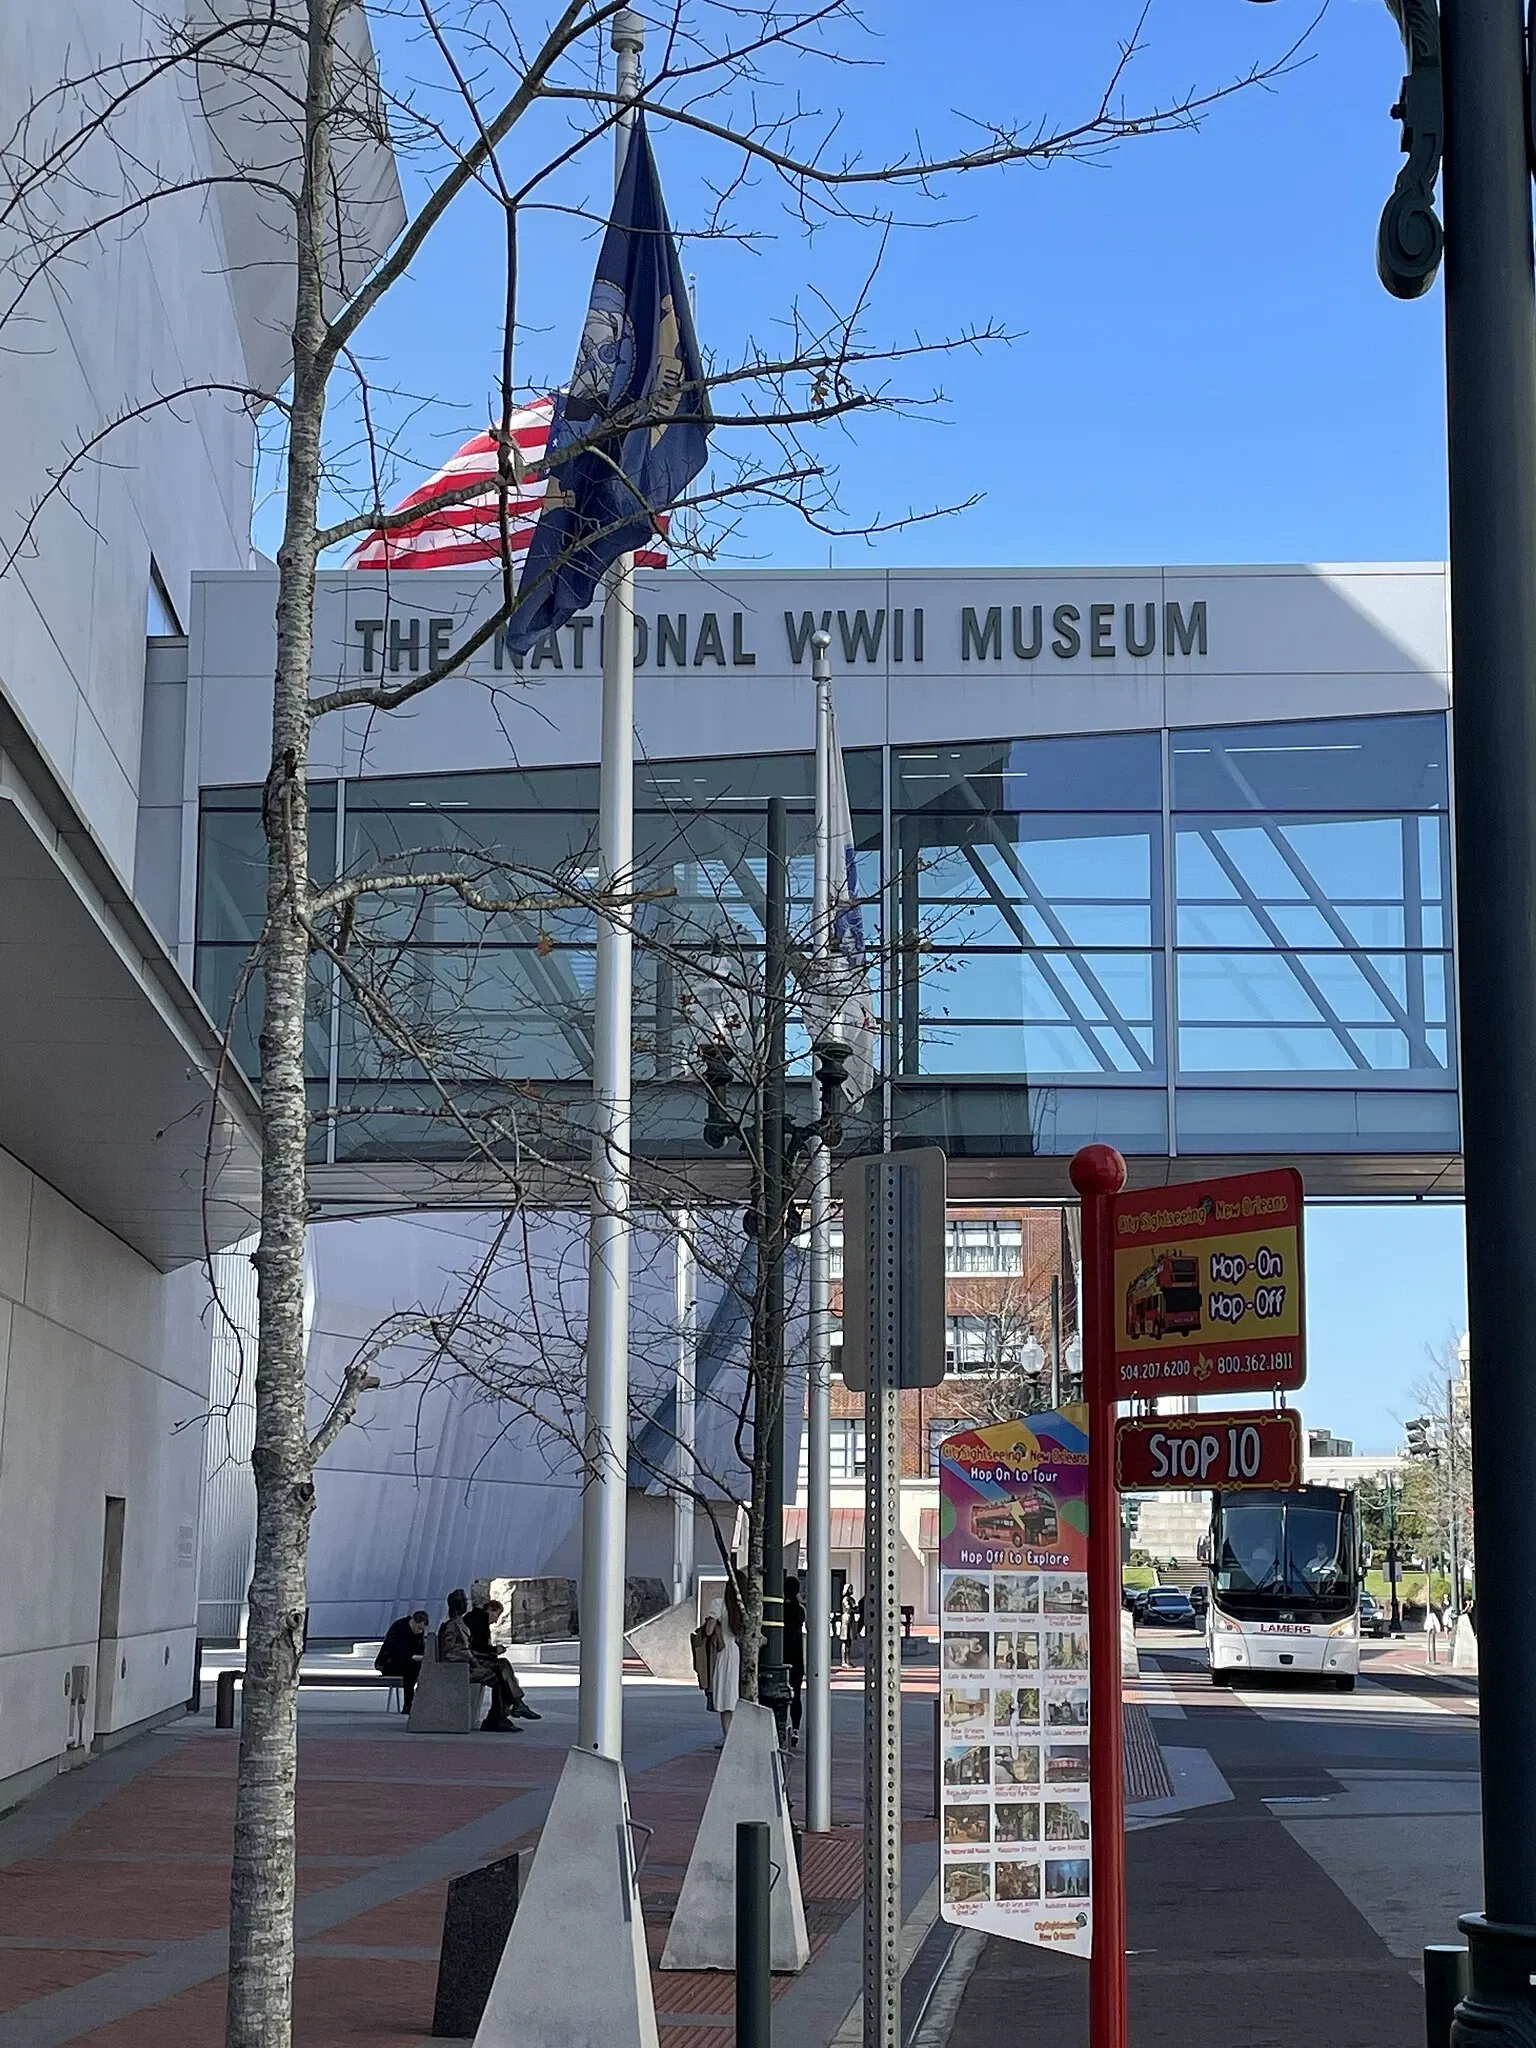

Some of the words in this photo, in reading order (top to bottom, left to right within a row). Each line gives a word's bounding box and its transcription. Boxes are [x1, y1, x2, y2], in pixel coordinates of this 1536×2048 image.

[354, 618, 454, 672] THE
[784, 608, 924, 664] WWII
[961, 601, 1208, 661] MUSEUM
[1216, 1200, 1240, 1220] New
[1241, 1195, 1288, 1217] Orleans
[1120, 1359, 1192, 1381] 504.207.6200
[1217, 1351, 1293, 1374] 800.362.1811
[1030, 1449, 1049, 1462] New
[1228, 1426, 1261, 1478] 10
[970, 1467, 992, 1482] Hop
[995, 1467, 1011, 1481] On
[1015, 1469, 1029, 1482] to
[1033, 1469, 1059, 1483] Tour
[961, 1549, 983, 1565] Hop
[986, 1549, 1005, 1565] Off
[1009, 1551, 1023, 1565] to
[1026, 1550, 1070, 1566] Explore
[1260, 1623, 1312, 1634] LAMERS
